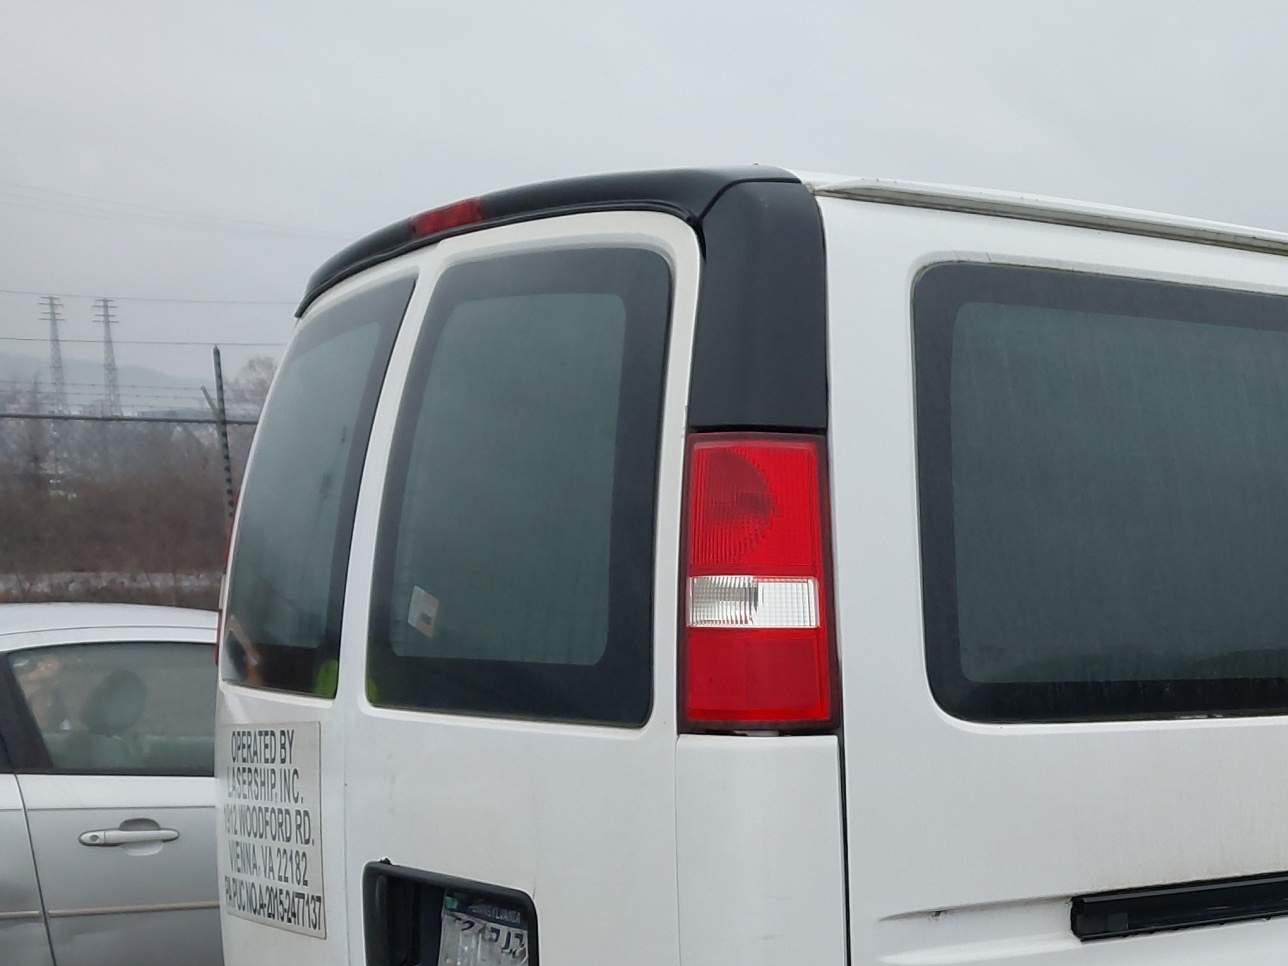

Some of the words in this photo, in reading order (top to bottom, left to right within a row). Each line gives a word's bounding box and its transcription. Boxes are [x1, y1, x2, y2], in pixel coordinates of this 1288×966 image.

[231, 730, 277, 764] OPERATED
[280, 729, 294, 764] BY
[280, 767, 304, 804] INC.
[239, 804, 292, 843] WOODFORD
[295, 809, 315, 846] RD.
[261, 844, 275, 880] VA
[277, 847, 309, 887] 22182
